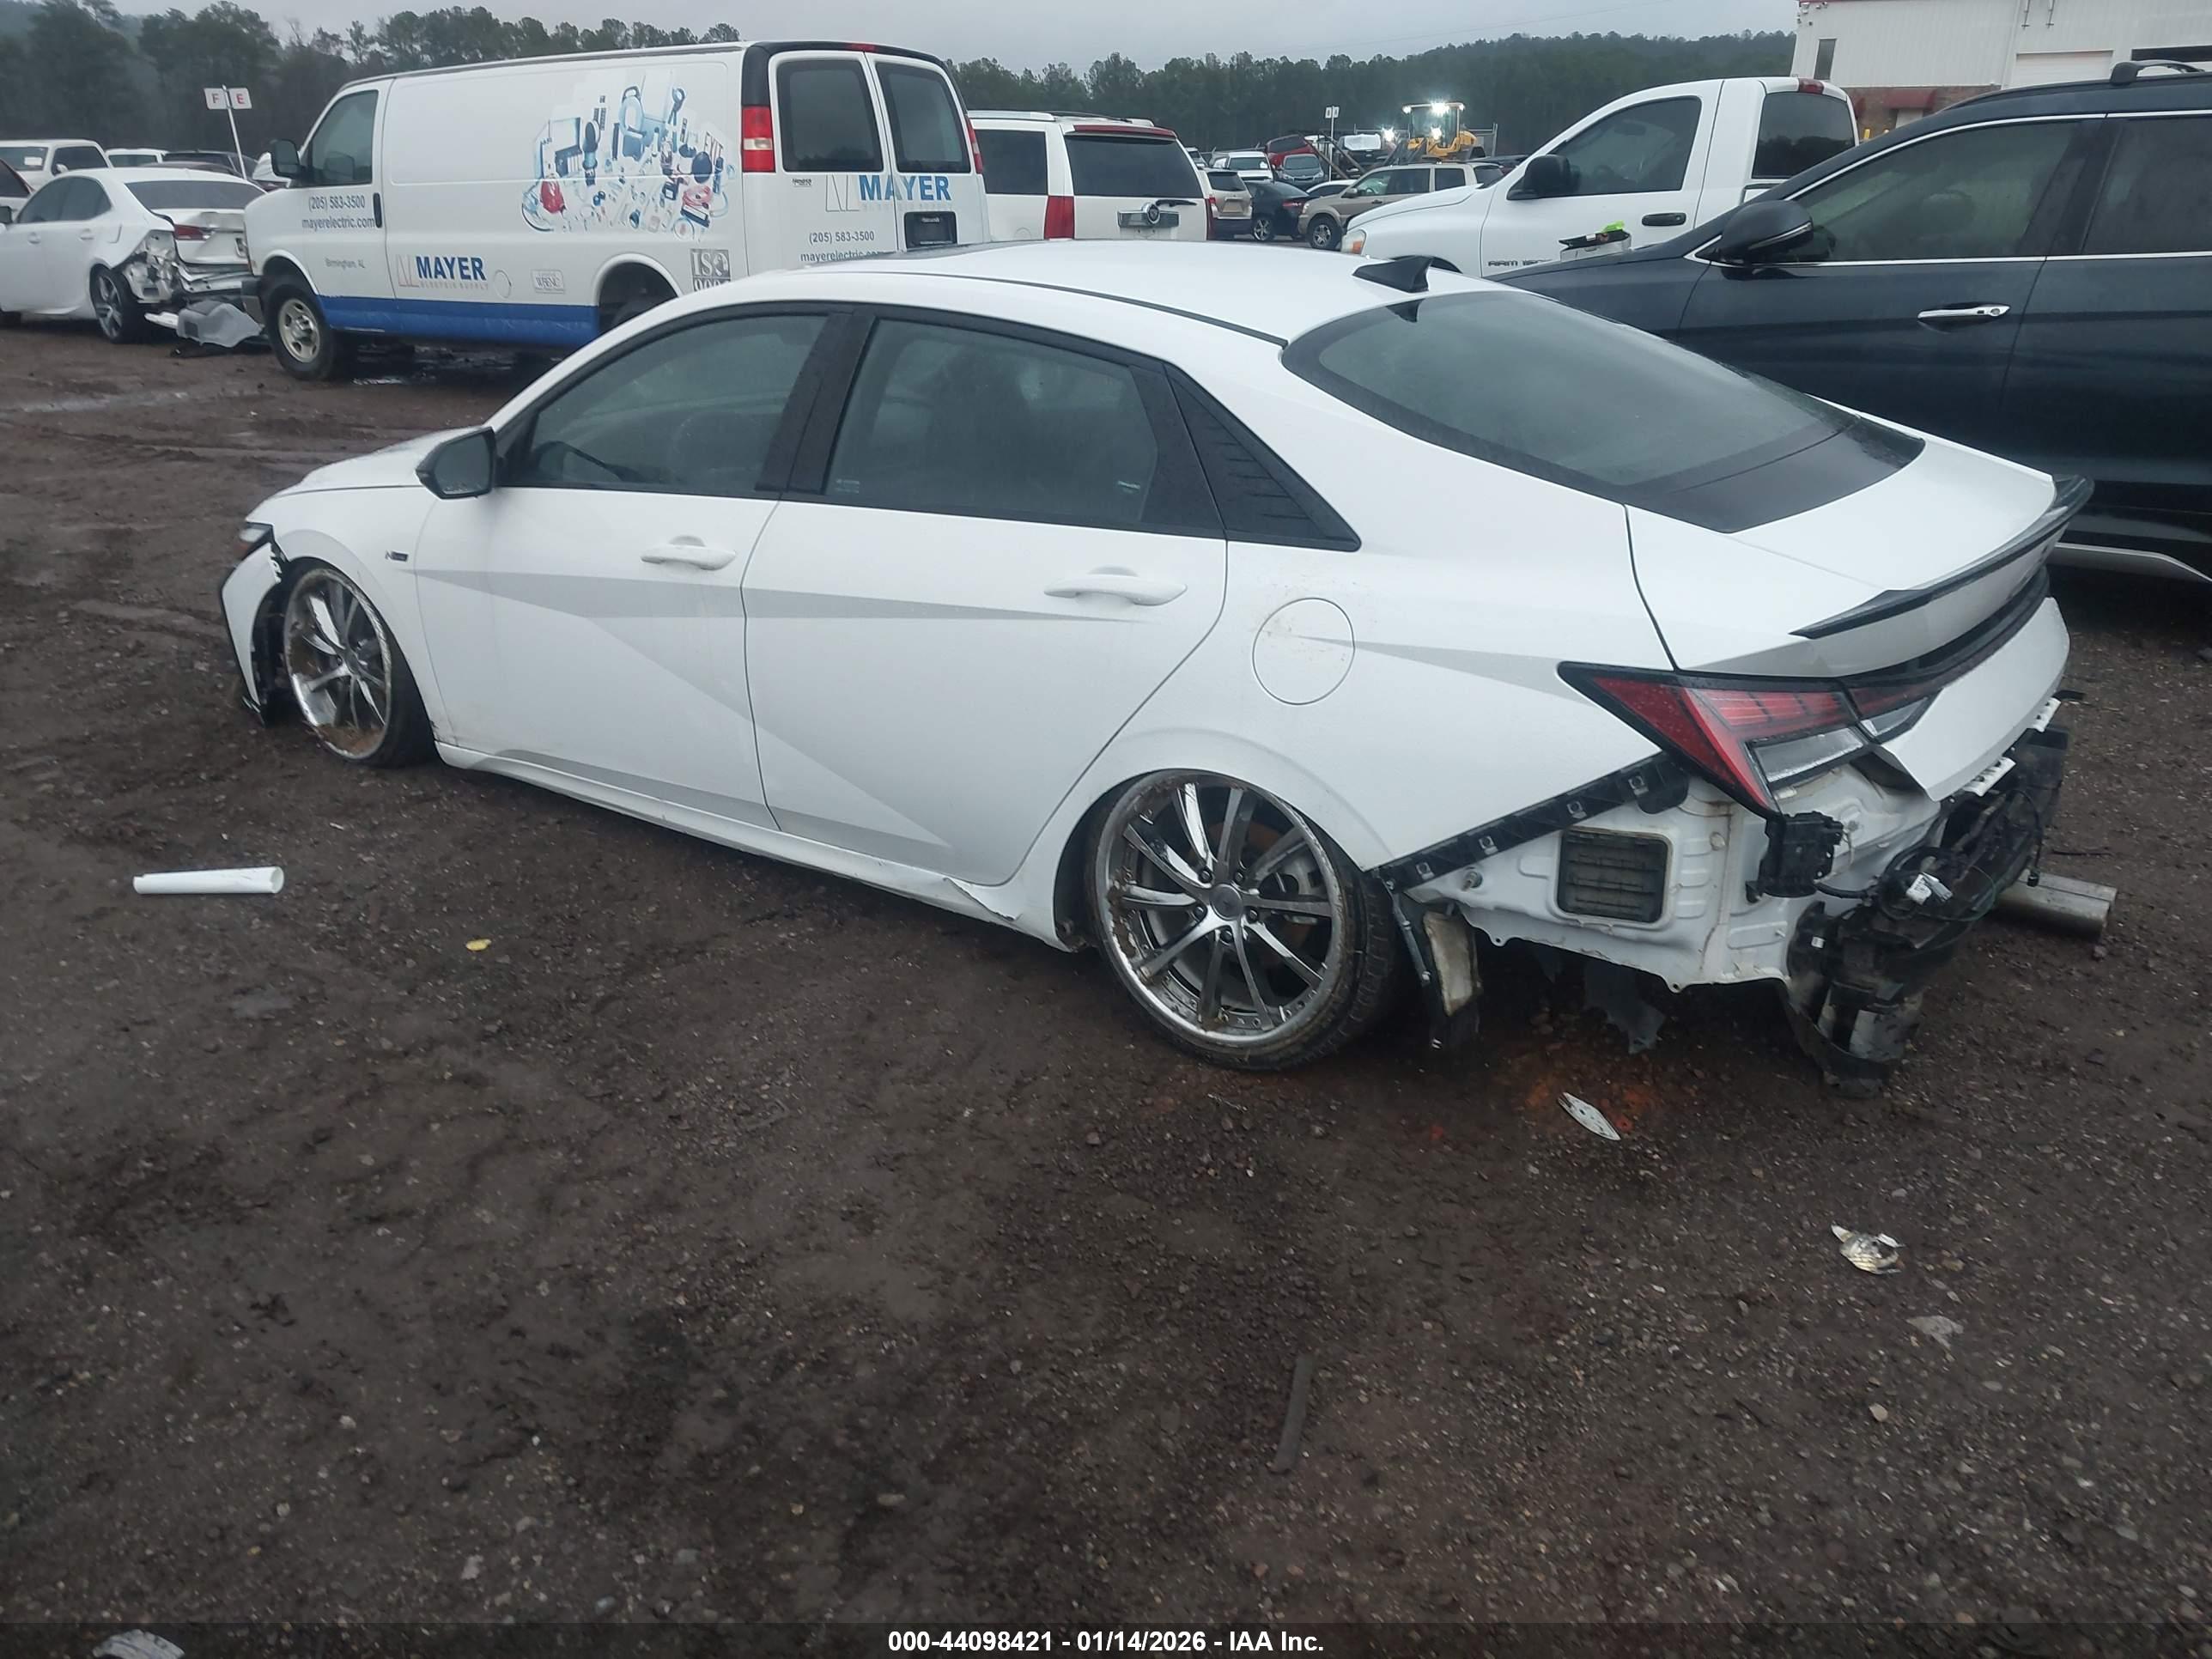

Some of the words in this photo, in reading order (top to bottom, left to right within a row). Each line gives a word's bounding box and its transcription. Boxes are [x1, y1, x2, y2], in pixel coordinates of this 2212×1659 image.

[212, 93, 220, 104] F
[236, 93, 246, 104] E
[859, 174, 951, 201] MAYER
[329, 194, 366, 210] 583-3500
[301, 216, 375, 232] mayerelectric.com
[809, 232, 833, 245] (205)
[835, 230, 875, 242] 583-3500
[416, 256, 487, 282] MAYER
